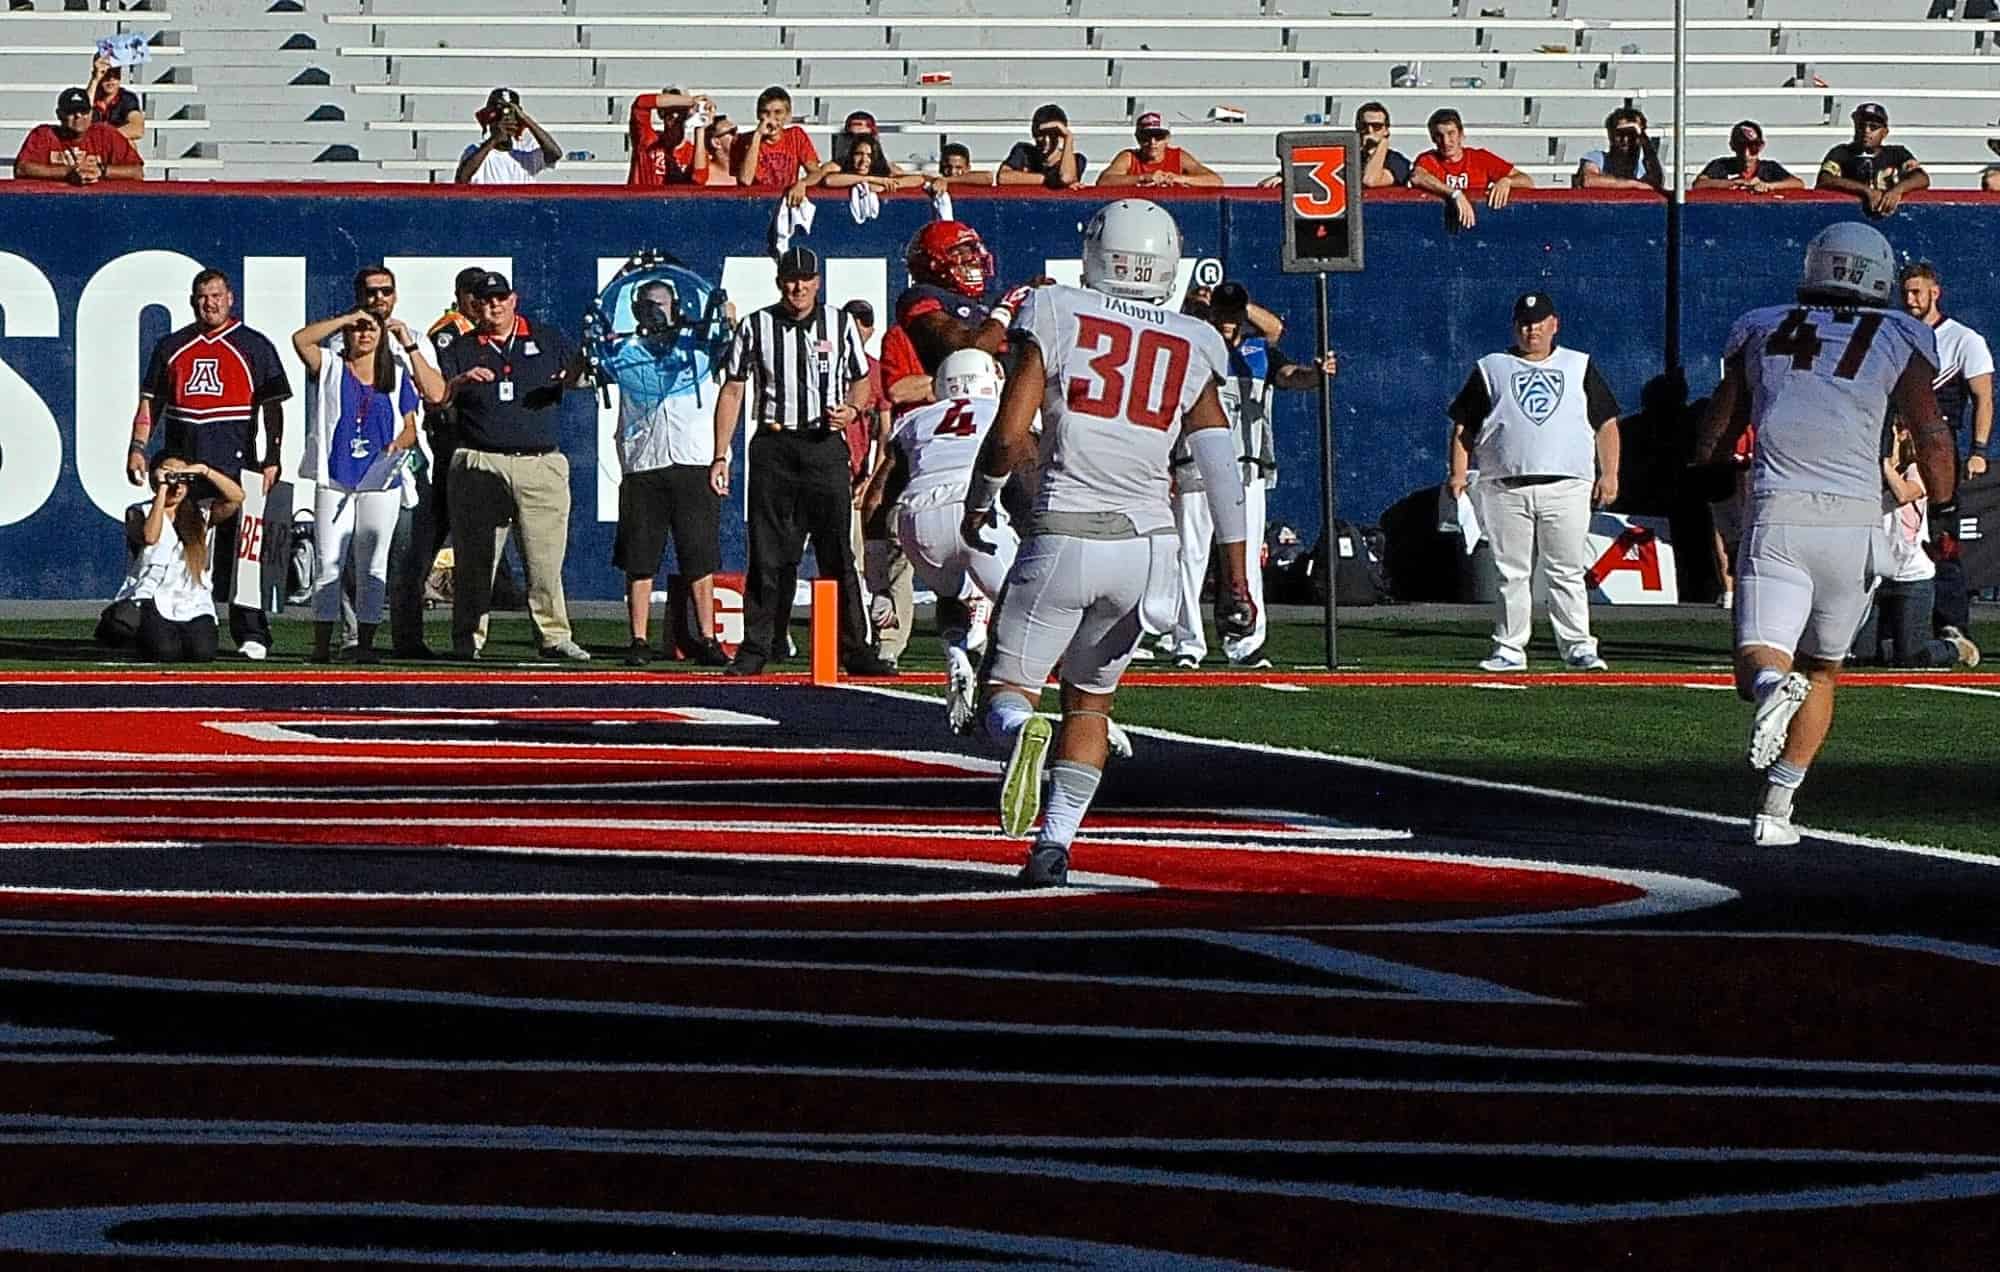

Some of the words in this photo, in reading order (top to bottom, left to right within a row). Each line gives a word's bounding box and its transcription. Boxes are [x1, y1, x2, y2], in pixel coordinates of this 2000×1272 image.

[1291, 147, 1346, 218] 3
[1134, 266, 1153, 282] 30
[1764, 309, 1885, 380] 47
[184, 358, 224, 396] A
[1067, 313, 1191, 432] 30
[933, 399, 977, 436] 4
[1528, 397, 1549, 413] 12
